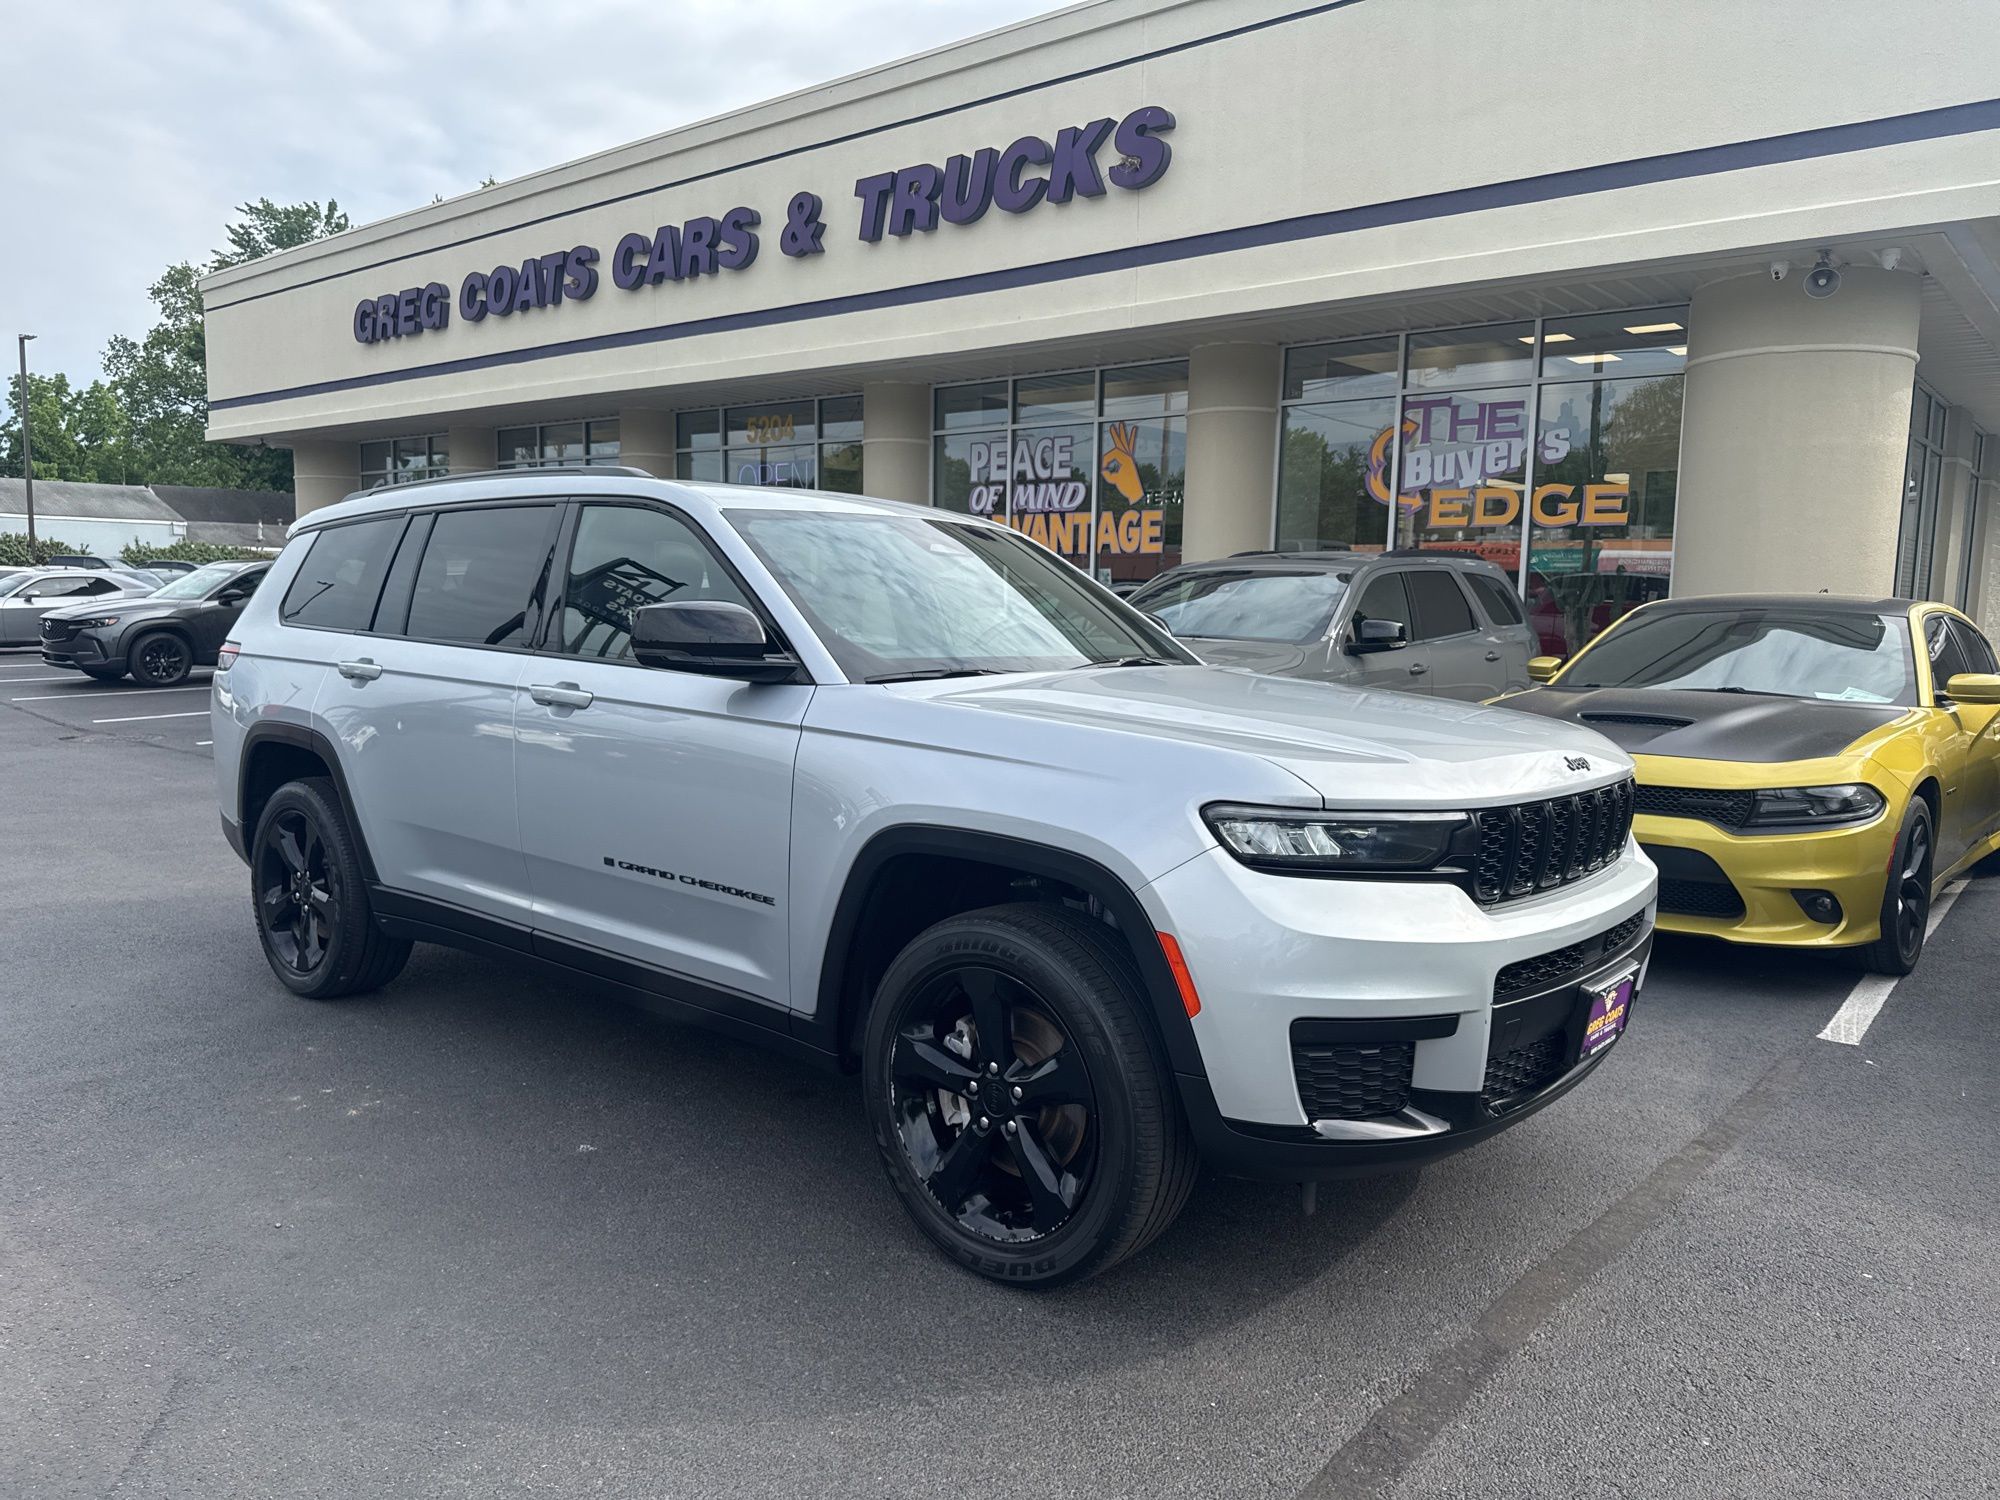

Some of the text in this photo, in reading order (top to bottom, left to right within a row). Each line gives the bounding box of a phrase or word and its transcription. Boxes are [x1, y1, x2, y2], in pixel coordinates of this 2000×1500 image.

[354, 105, 1177, 344] GREG COATS CARS & TRUCKS
[746, 414, 796, 444] 5204
[1402, 397, 1525, 447] THE
[738, 461, 809, 490] OPEN
[970, 436, 1073, 483] PEACE
[1401, 427, 1572, 492] Buyers
[969, 482, 1086, 514] OF MIND
[1427, 483, 1630, 528] EDGE
[1563, 756, 1591, 771] Jeep
[618, 860, 776, 907] GRAND CHEROKEE
